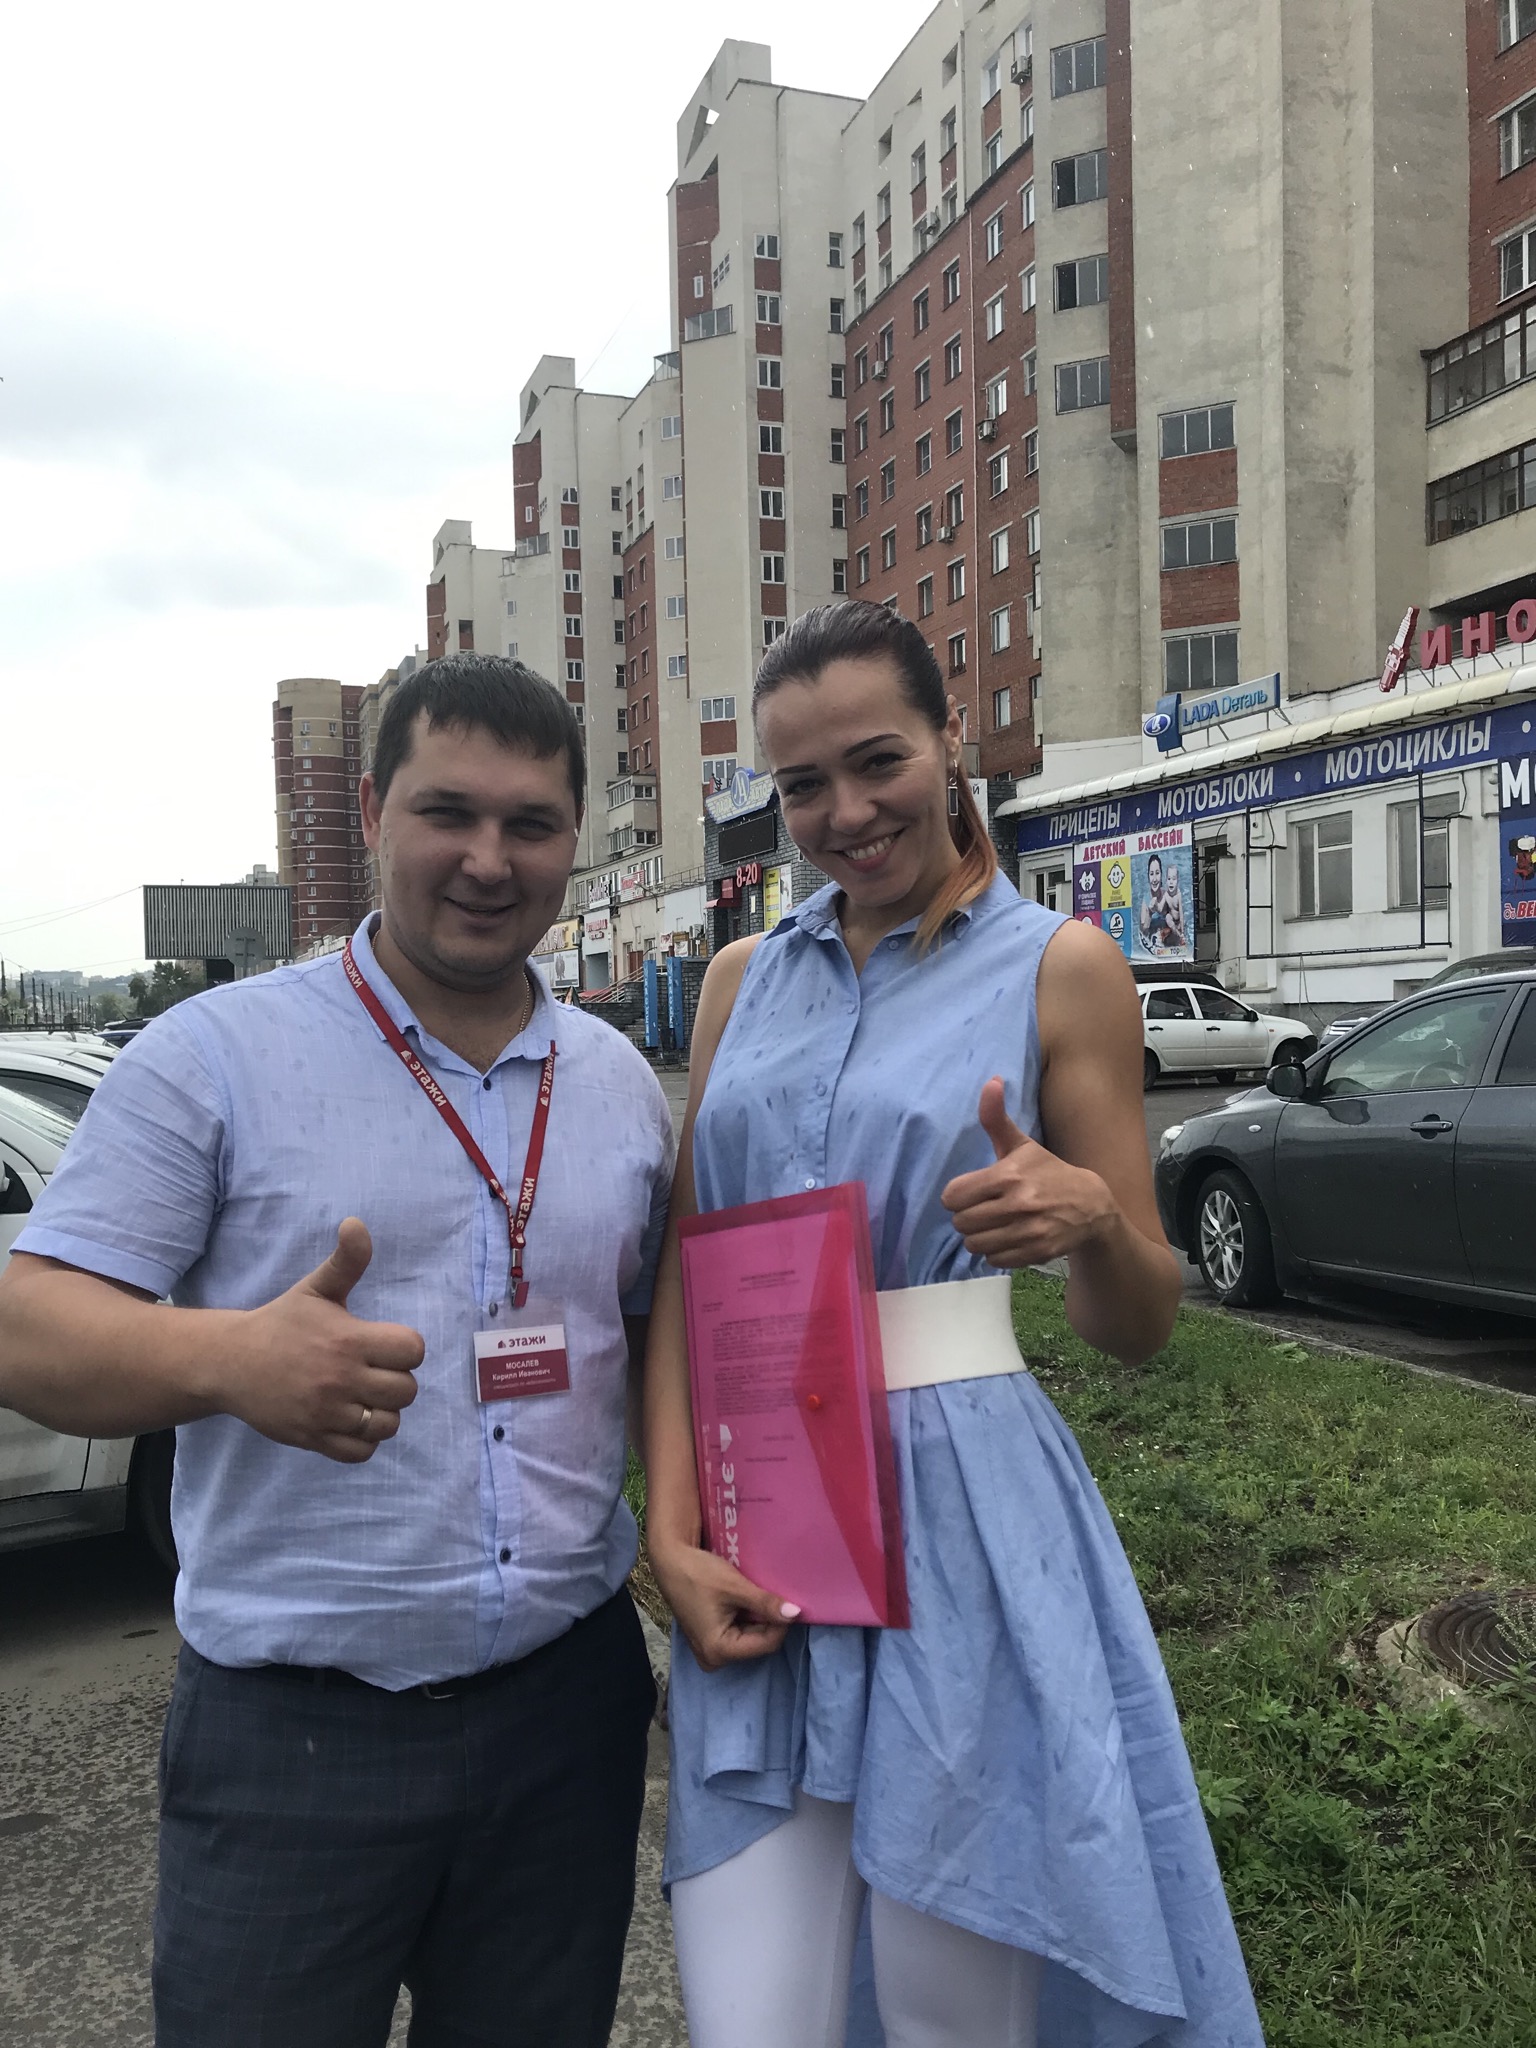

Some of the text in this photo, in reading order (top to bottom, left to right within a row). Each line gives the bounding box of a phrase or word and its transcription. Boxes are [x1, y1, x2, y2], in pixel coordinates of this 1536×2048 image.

[1182, 699, 1220, 727] LADA
[1049, 716, 1492, 841] ПРИЦЕПЫ МОТОБЛОКИ МОТОЦИКЛЫ
[1083, 828, 1184, 862] ДЕТСКИЙ БАССЕЙН
[736, 861, 758, 888] 8-20
[409, 1060, 447, 1107] этажи
[541, 1052, 554, 1094] этажи
[516, 1177, 535, 1229] этажи
[509, 1335, 546, 1348] этажи
[492, 1368, 550, 1382] Кирилл Иванович
[505, 1359, 539, 1370] МОСАЛЕВ
[722, 1462, 740, 1568] этаж
